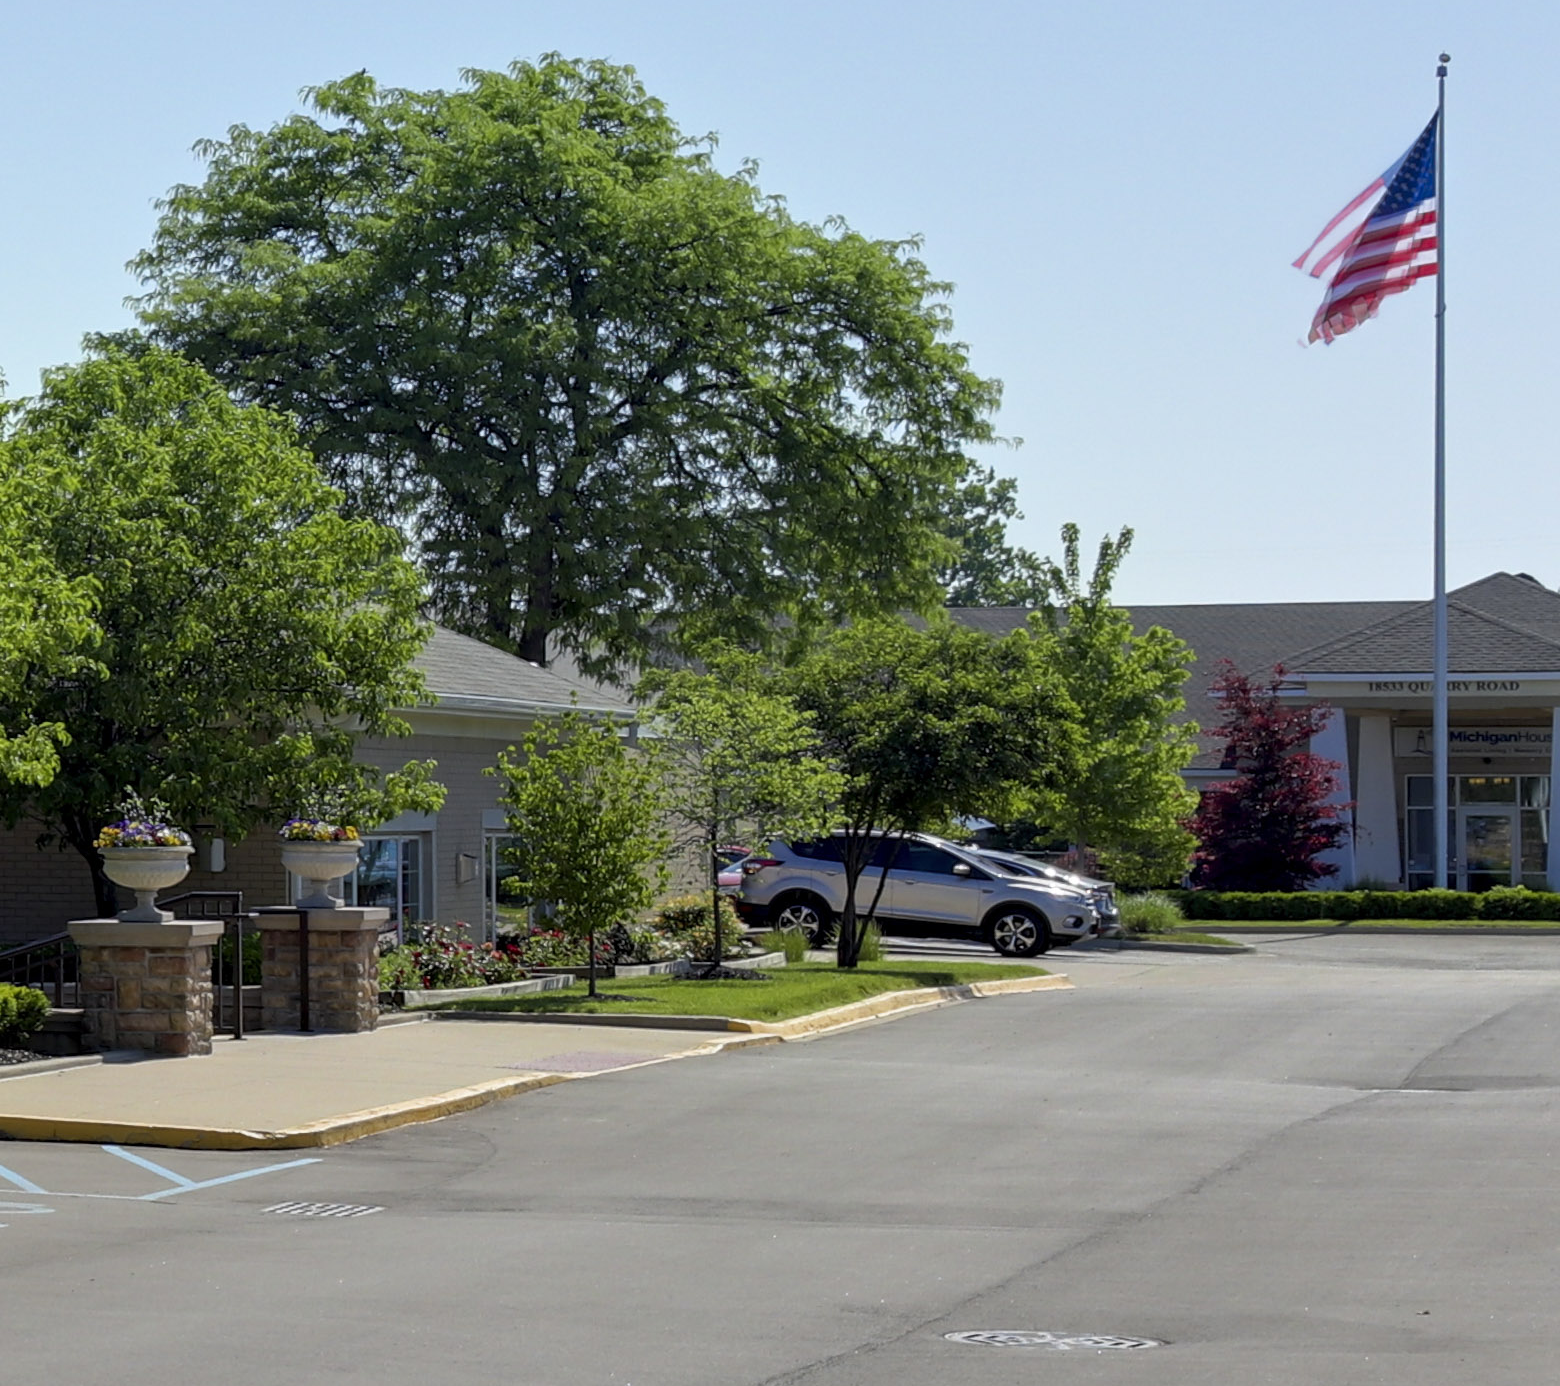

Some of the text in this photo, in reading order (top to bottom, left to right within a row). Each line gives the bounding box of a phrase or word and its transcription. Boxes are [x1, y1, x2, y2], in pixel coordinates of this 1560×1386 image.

[1368, 680, 1520, 694] 18533 QURY ROAD
